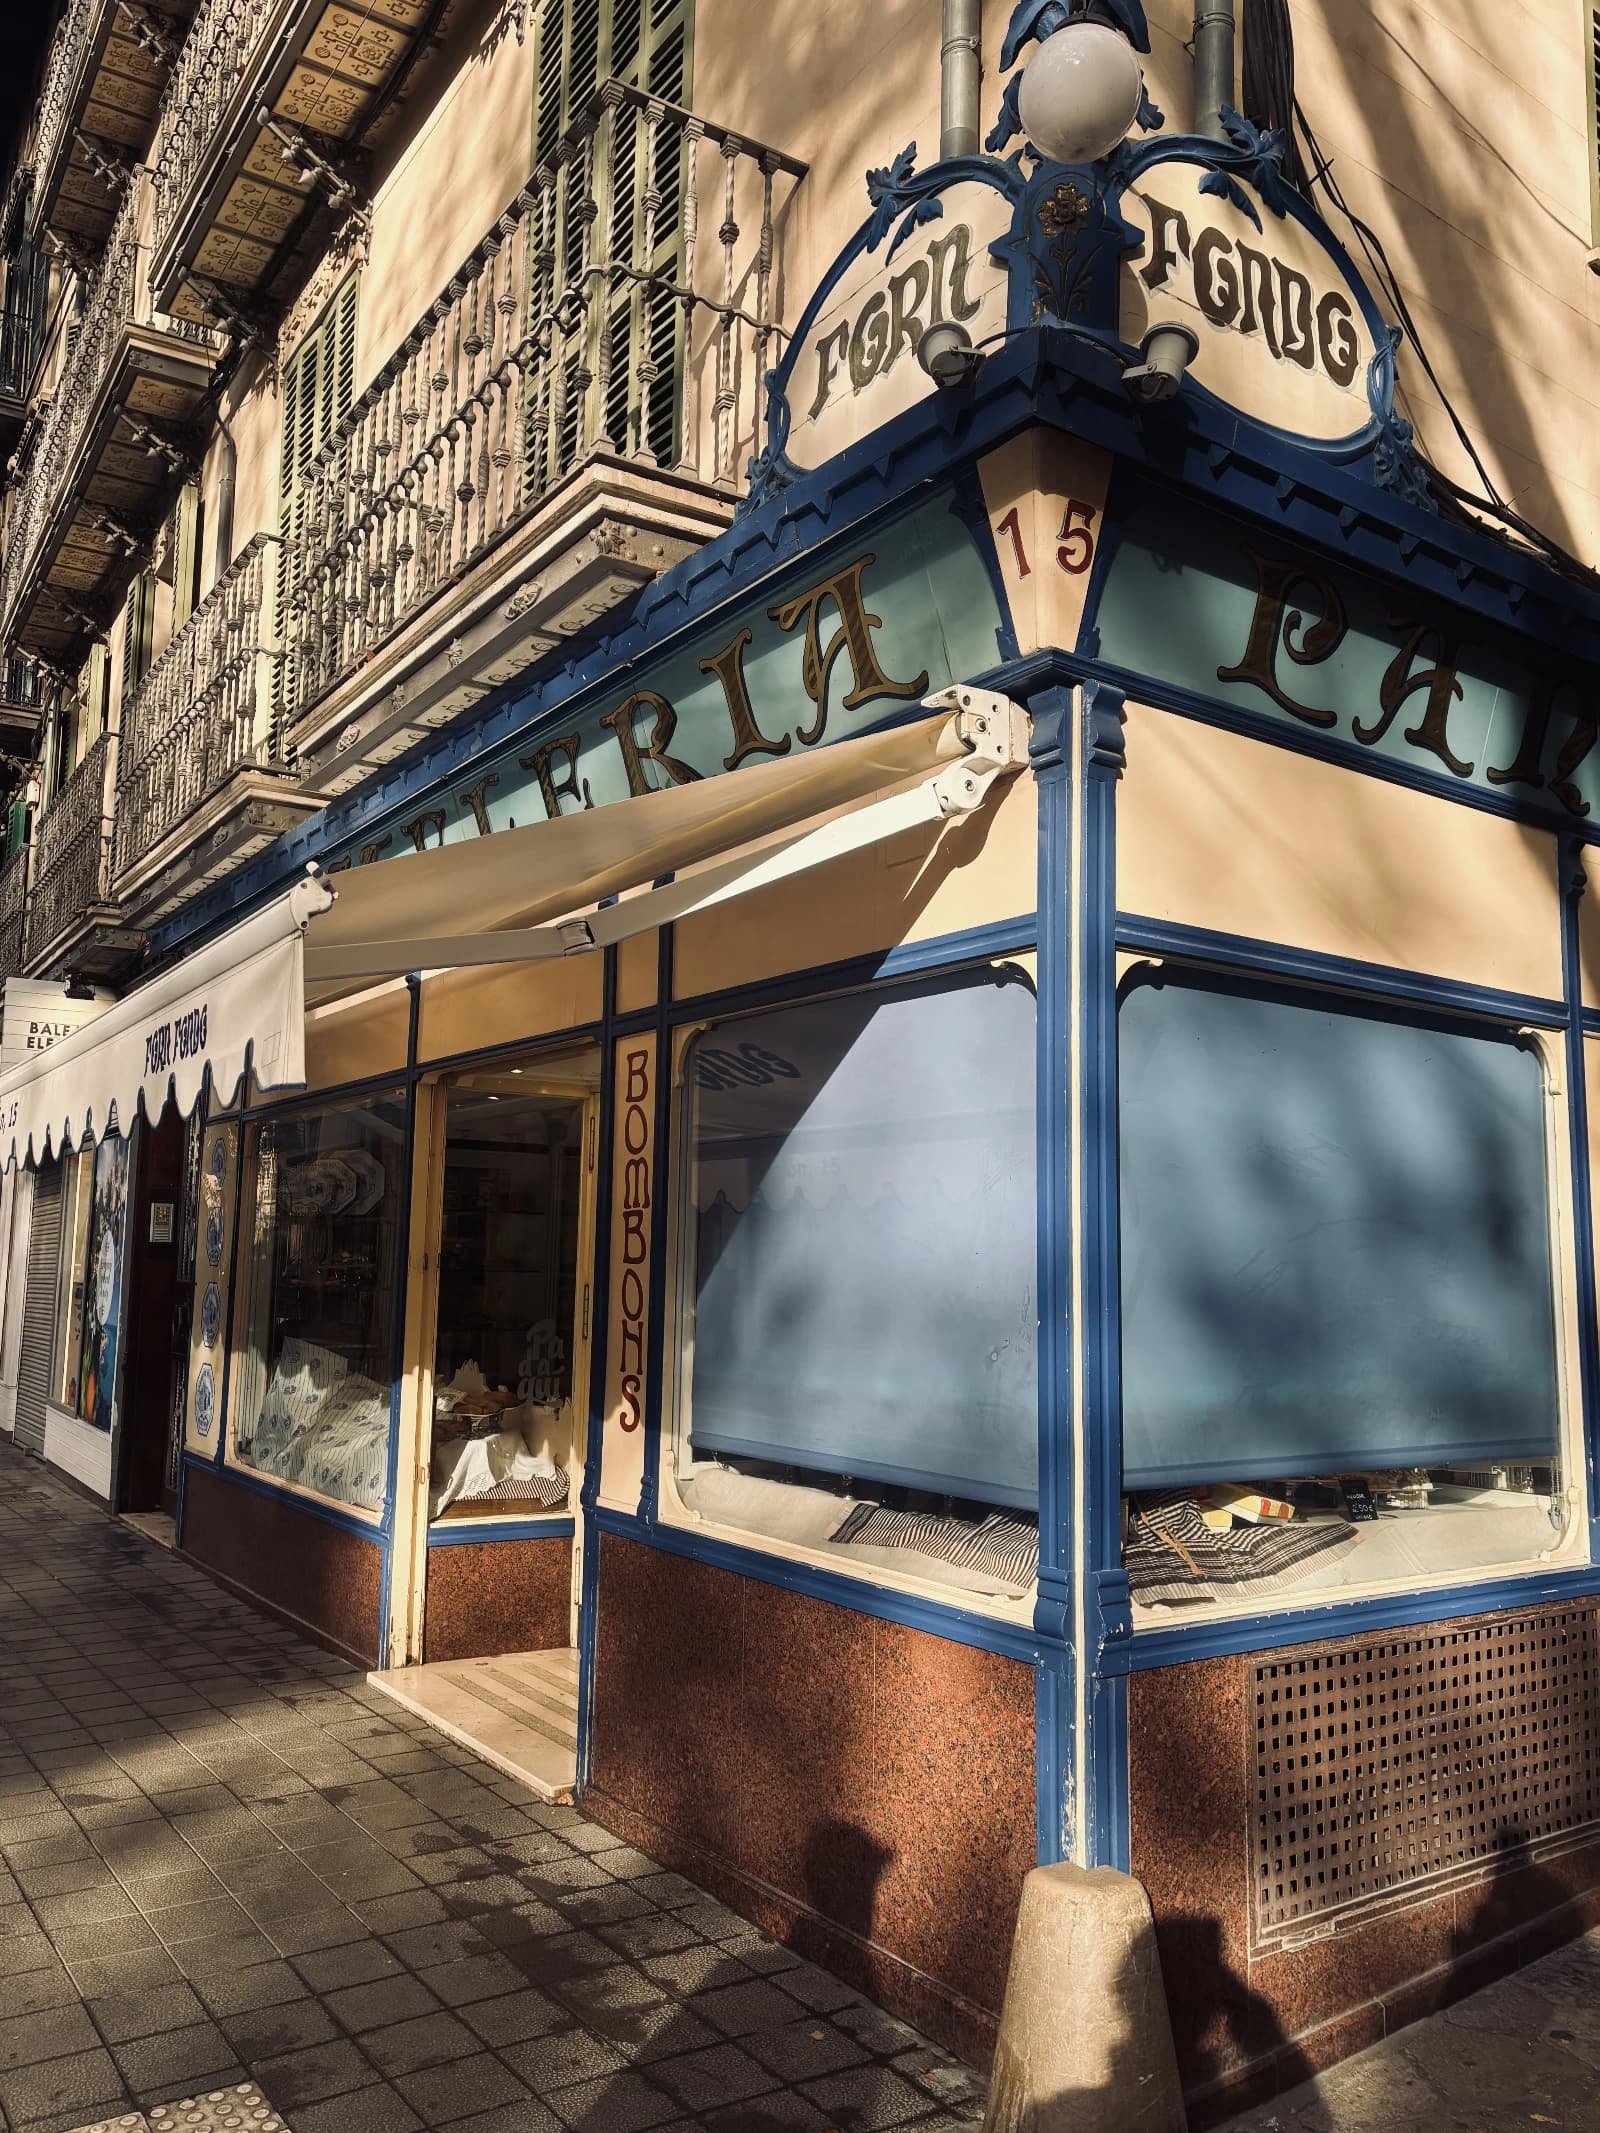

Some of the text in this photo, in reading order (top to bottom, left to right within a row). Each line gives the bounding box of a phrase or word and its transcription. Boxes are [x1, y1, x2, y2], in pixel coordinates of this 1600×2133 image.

[808, 223, 981, 421] FORN
[1139, 193, 1360, 388] FONDO
[995, 499, 1097, 579] 15
[26, 1036, 55, 1050] ELE
[29, 1021, 79, 1037] BALE
[144, 1003, 208, 1078] FORN FONDO
[619, 1049, 650, 1433] BOMBONS
